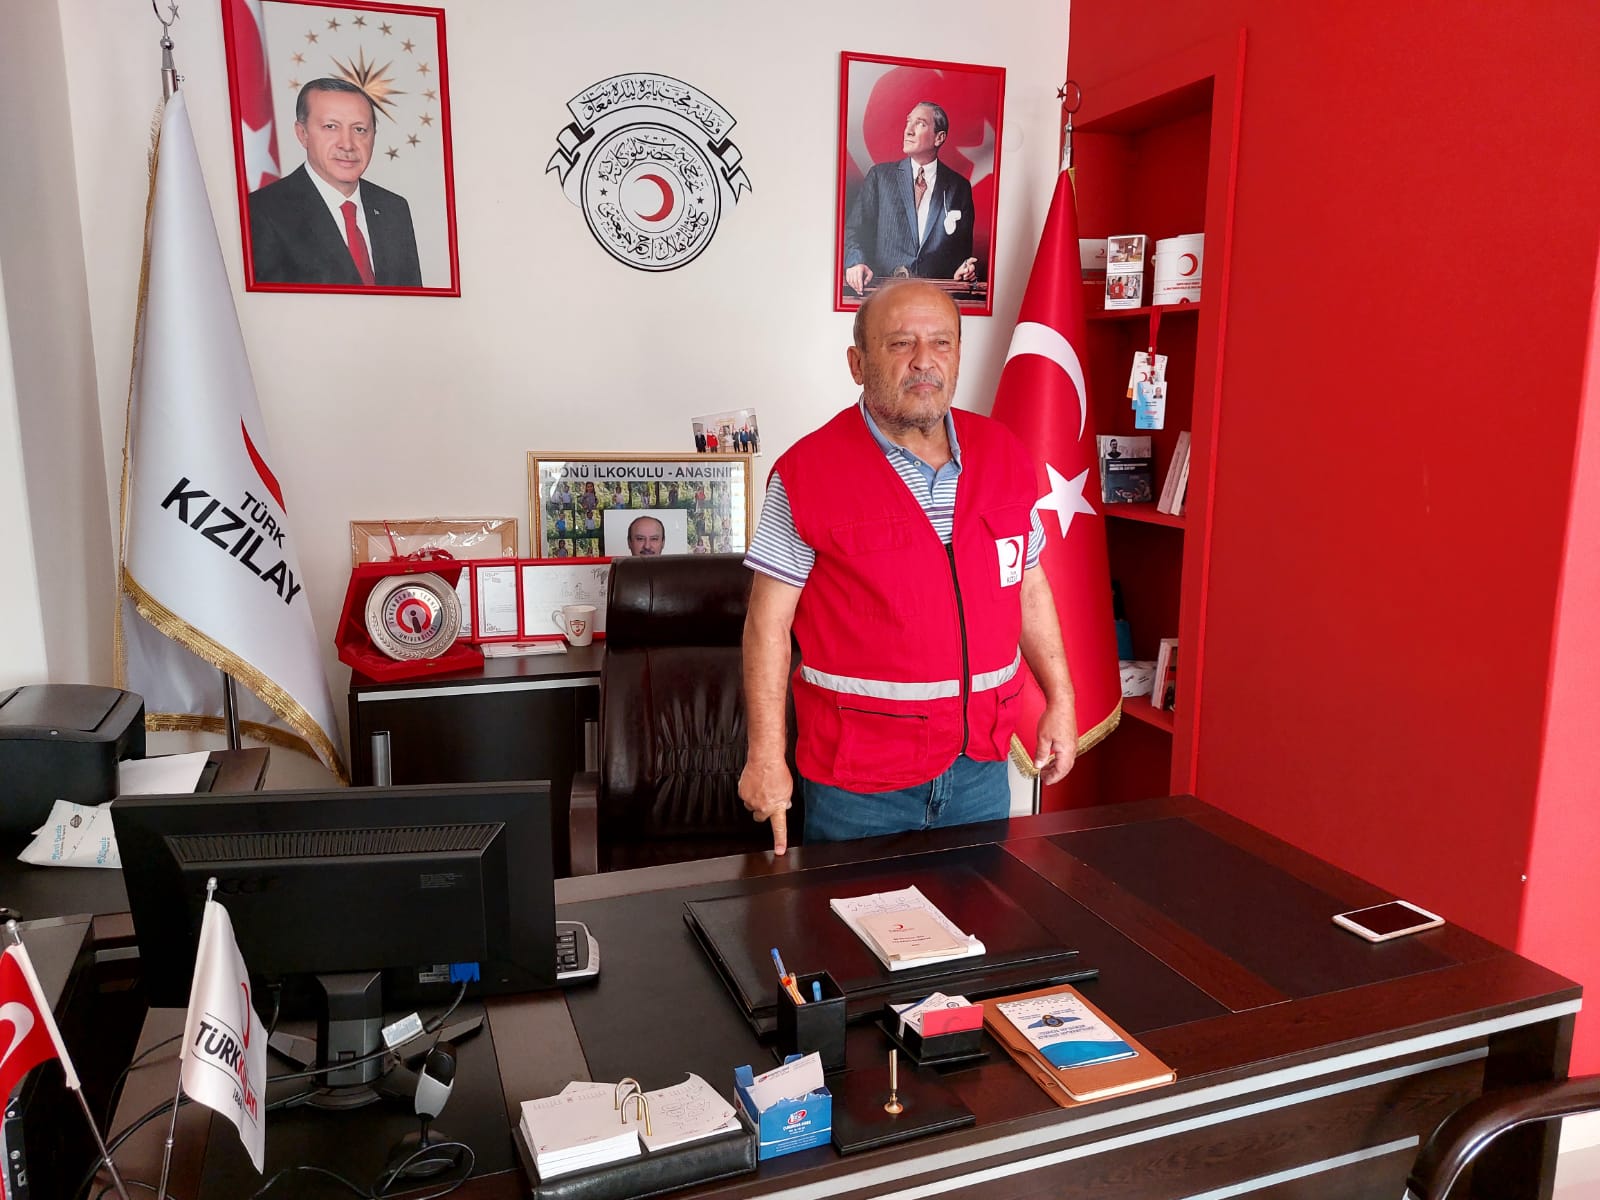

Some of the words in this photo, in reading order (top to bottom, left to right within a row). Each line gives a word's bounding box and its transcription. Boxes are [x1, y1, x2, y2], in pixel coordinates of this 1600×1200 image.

[594, 463, 664, 479] İLKOKULU
[160, 476, 302, 606] KIZILAY
[240, 490, 286, 549] TÜRK
